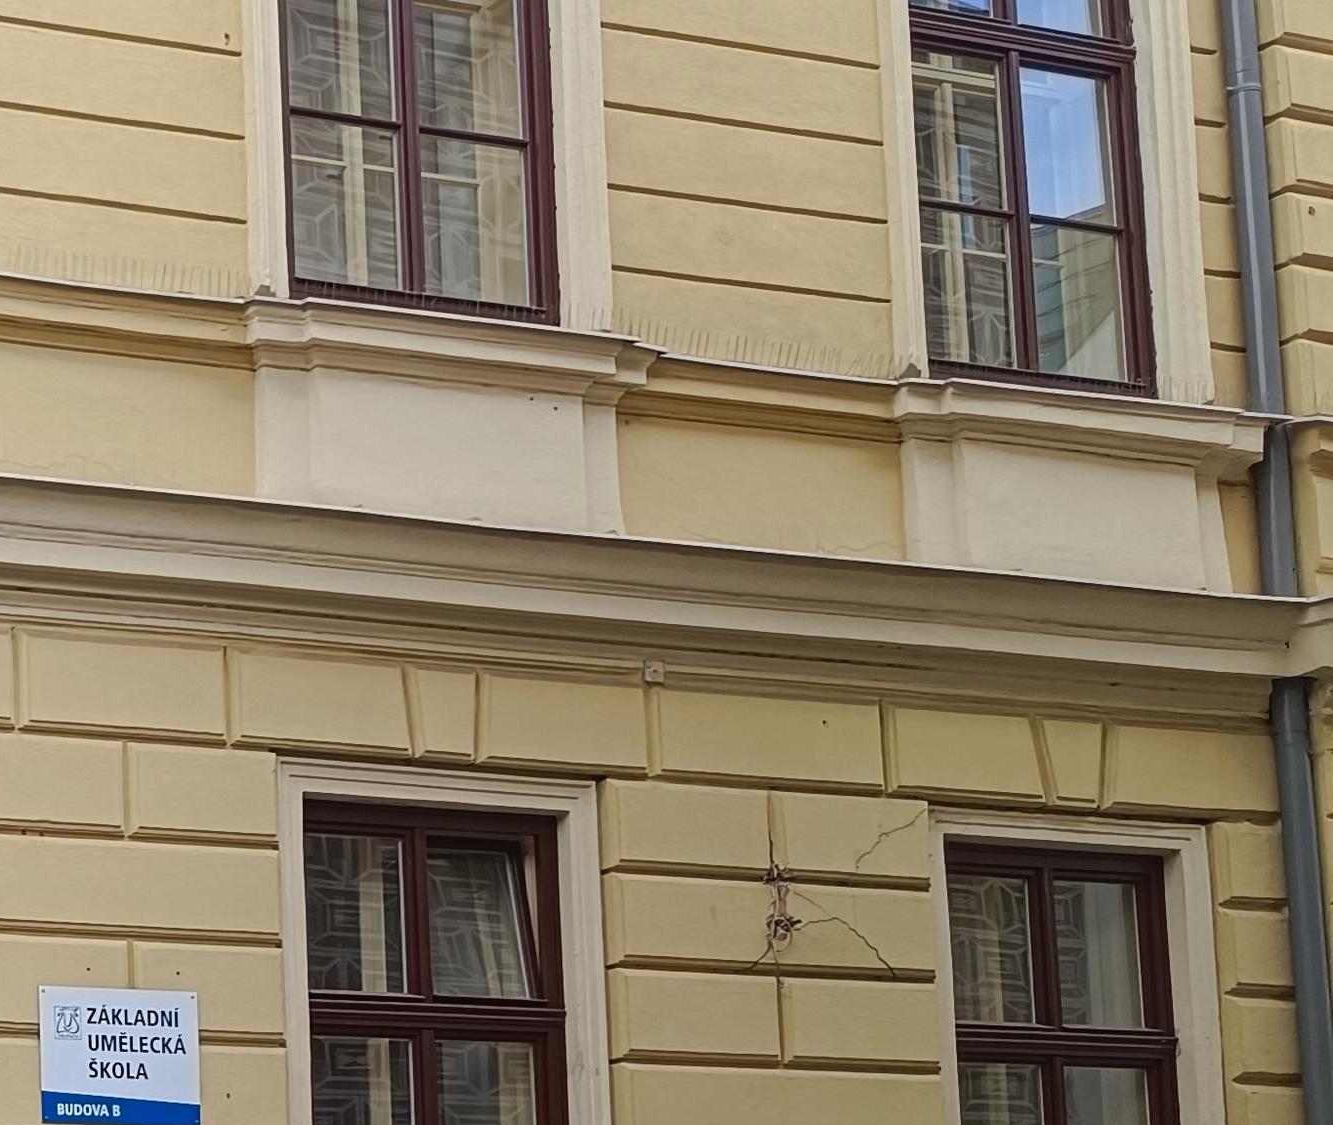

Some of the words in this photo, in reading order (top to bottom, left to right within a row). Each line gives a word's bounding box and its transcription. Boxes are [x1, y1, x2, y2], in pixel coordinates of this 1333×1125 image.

[87, 1004, 180, 1028] ZÁKLADNÍ
[88, 1032, 187, 1055] UMĚLECKÁ
[89, 1058, 149, 1080] ŠKOLA
[56, 1102, 110, 1118] BUDOVA
[112, 1104, 121, 1118] B
